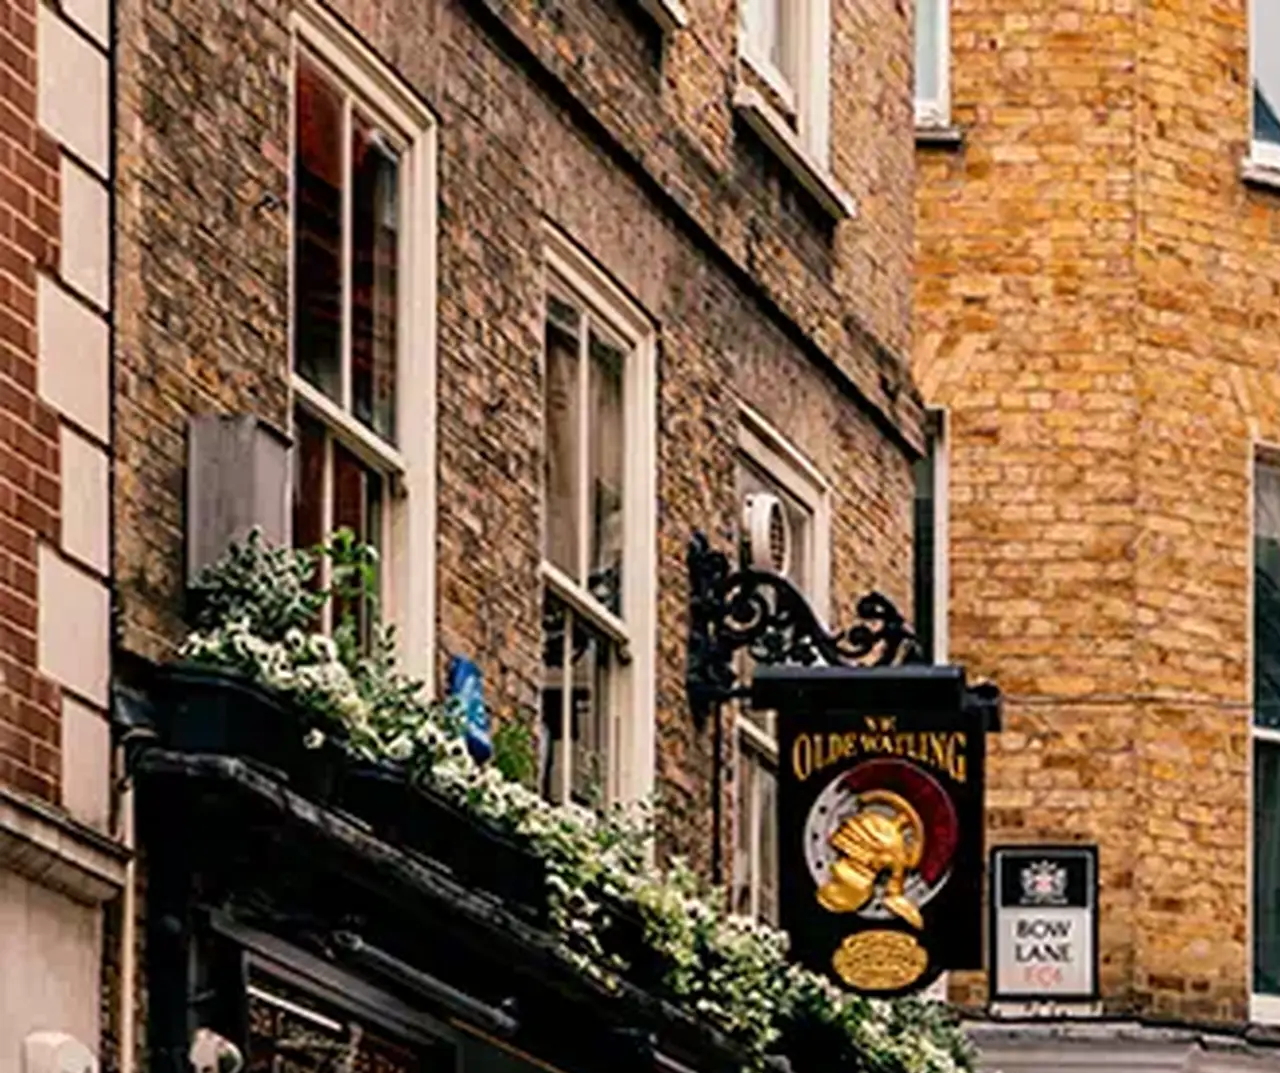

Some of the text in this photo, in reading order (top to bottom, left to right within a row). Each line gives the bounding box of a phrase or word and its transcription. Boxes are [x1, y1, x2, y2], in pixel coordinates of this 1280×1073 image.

[792, 731, 967, 784] OLDE WATLING
[1016, 919, 1071, 939] BOW
[1015, 943, 1073, 963] LANE
